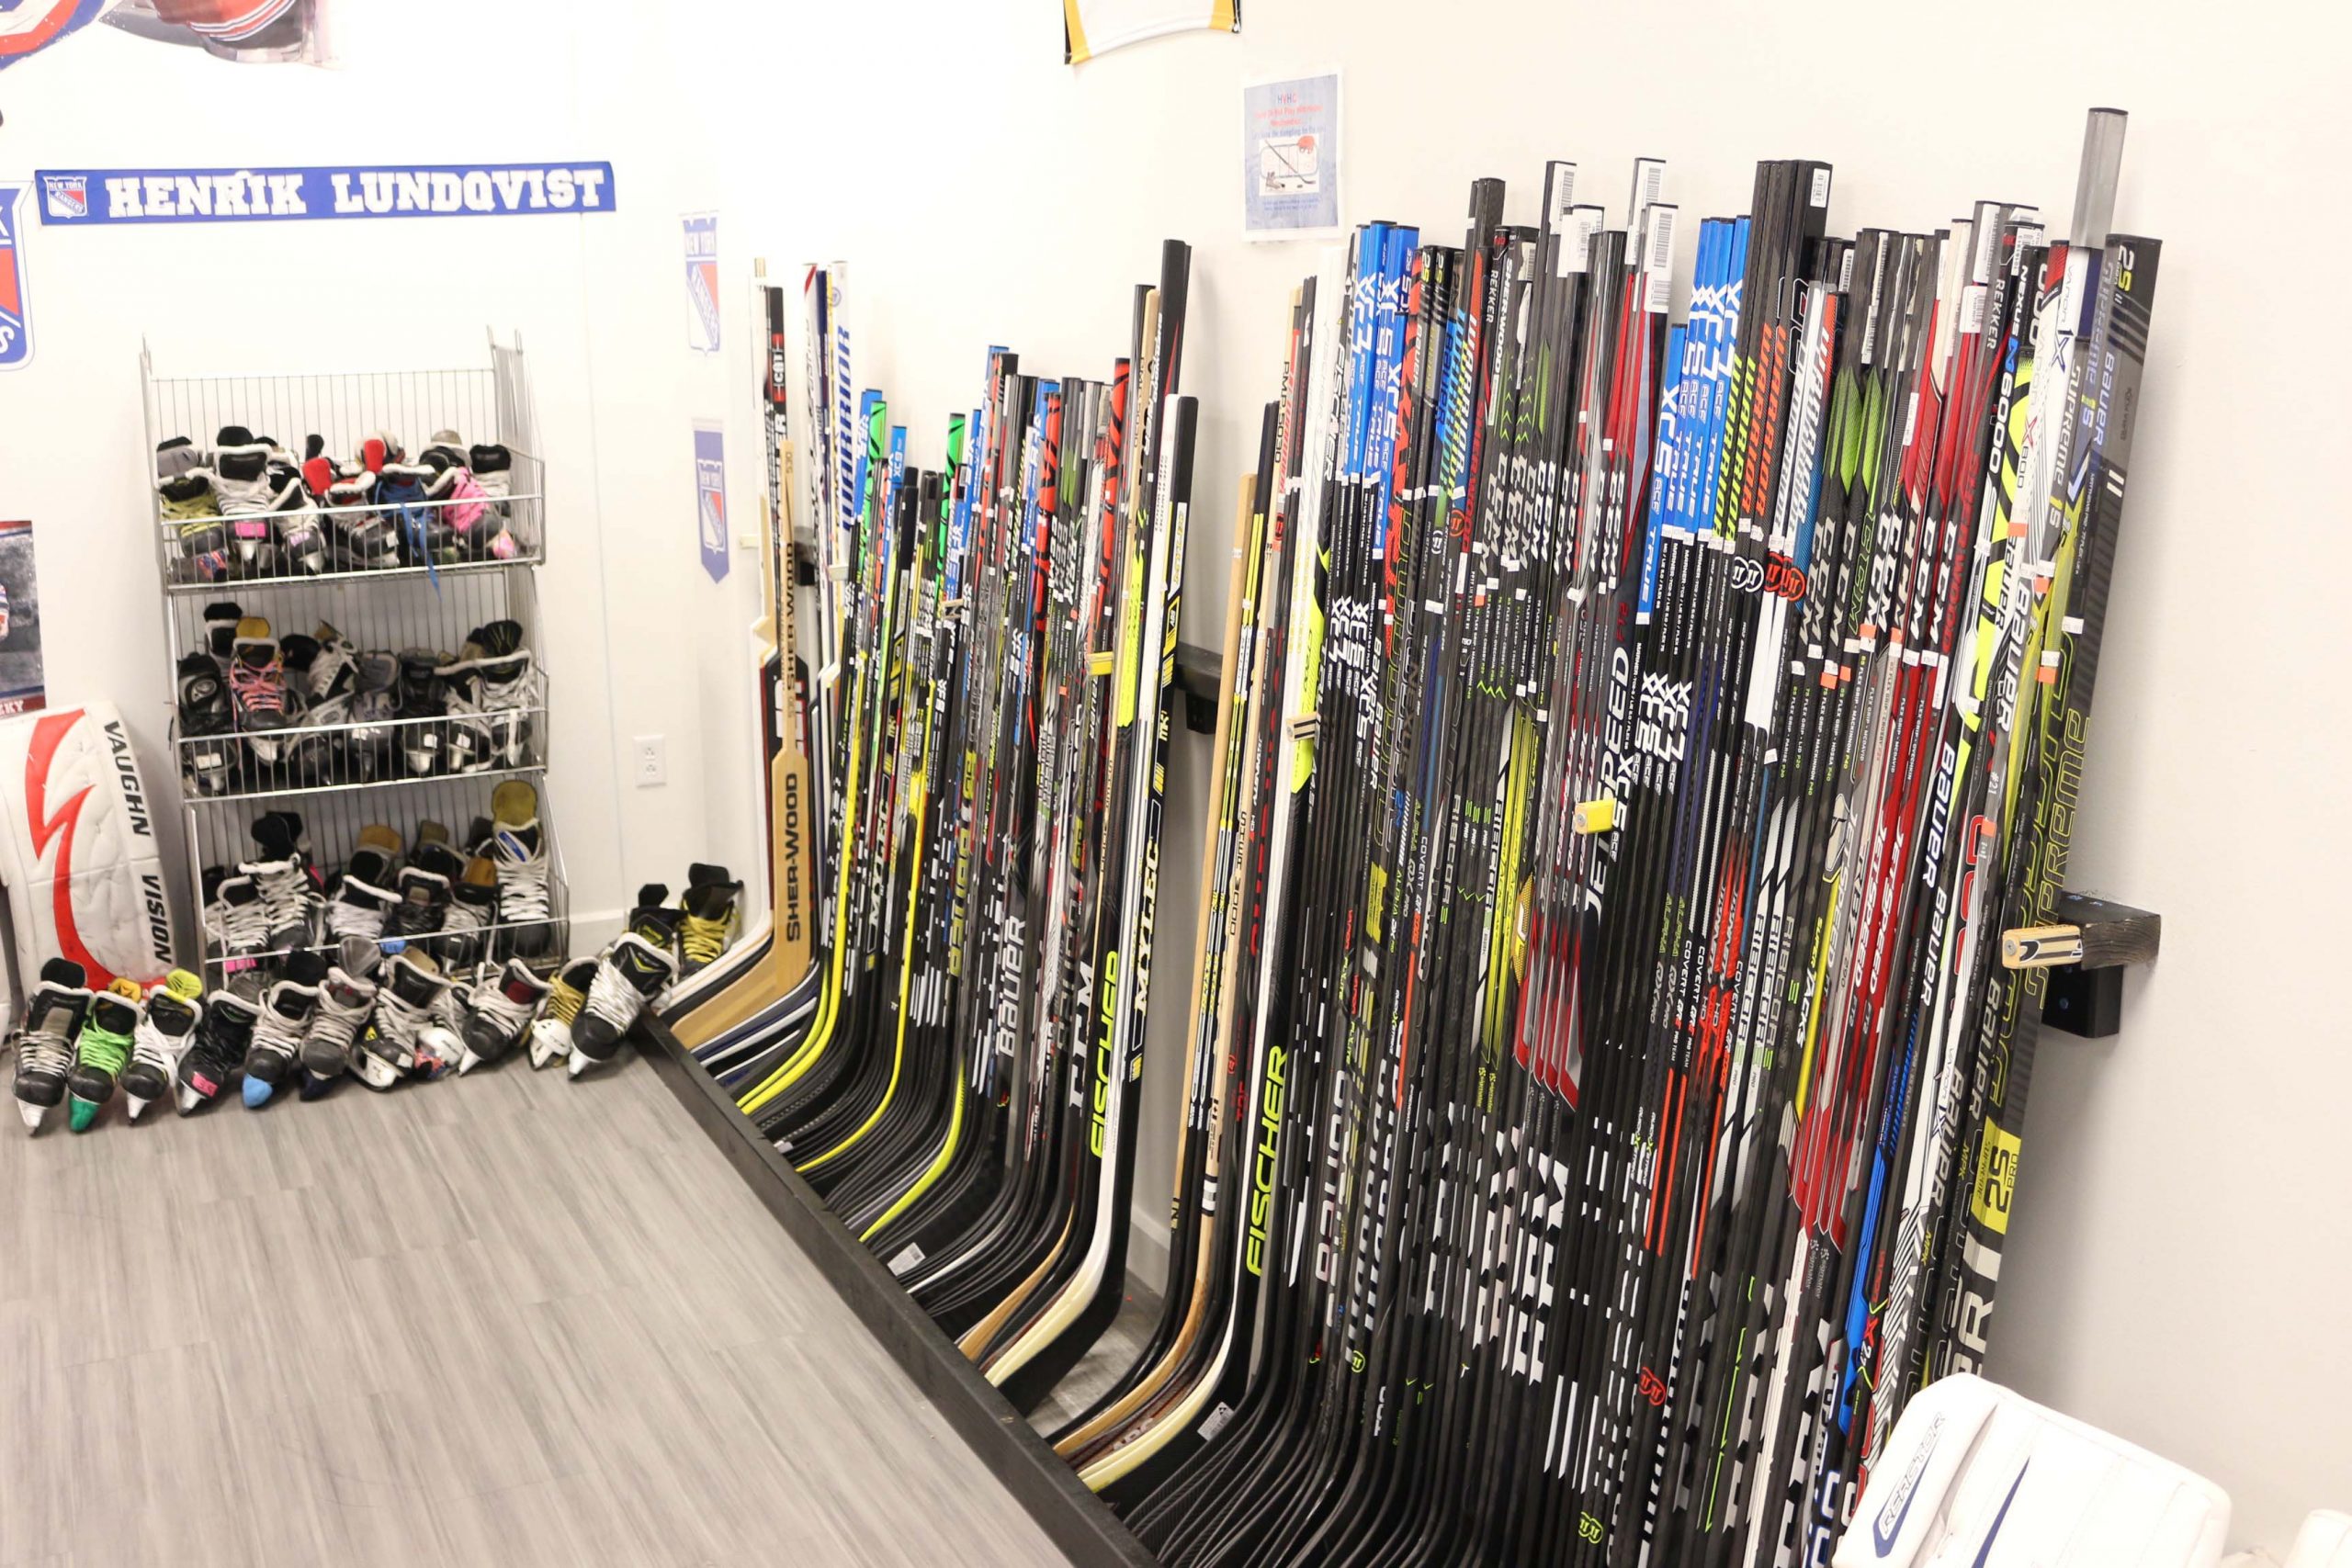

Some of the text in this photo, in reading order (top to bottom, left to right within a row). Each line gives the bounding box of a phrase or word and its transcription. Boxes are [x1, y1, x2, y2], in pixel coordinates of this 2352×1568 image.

[105, 168, 605, 218] HENRIK LUNDQVIST
[1486, 269, 1499, 323] REKKER
[1494, 258, 1513, 374] SHER-WOOD
[1986, 278, 2006, 349] REKKER
[2011, 265, 2029, 336] NEXUS
[2117, 245, 2134, 291] 2S
[1412, 323, 1423, 389] BAUER
[1717, 279, 1744, 378] XC7
[837, 325, 854, 533] WARRIOR
[1275, 412, 1285, 464] 5030
[1324, 342, 1345, 481] FISCHER
[1456, 312, 1477, 473] WARRIOR
[1653, 384, 1680, 478] XC5
[1742, 322, 1772, 514] WARRIOR
[1755, 326, 1787, 517] WARRIOR
[1797, 327, 1830, 525] WARRIOR
[2053, 358, 2081, 485] SUPREME
[2094, 351, 2115, 446] BAUER
[1374, 362, 1401, 547] XC5 TRUE
[1668, 431, 1682, 512] TRUE
[1677, 431, 1692, 512] TRUE
[1689, 435, 1703, 517] TRUE
[1702, 431, 1718, 514] TRUE
[1713, 354, 1742, 537] WARRIOR
[1724, 356, 1756, 542] WARRIOR
[2085, 473, 2095, 512] MATTHEWS
[1480, 473, 1497, 575] CCM
[1520, 465, 1537, 570] CCM
[1531, 459, 1547, 560] CCM
[1542, 460, 1556, 562] CCM
[1553, 467, 1570, 574] CCM
[1565, 472, 1579, 571] CCM
[1589, 470, 1605, 572] CCM
[1610, 470, 1625, 576] CCM
[1641, 526, 1657, 603] TRUE
[1812, 516, 1836, 641] CCM
[1829, 521, 1857, 647] CCM
[1848, 513, 1876, 636] CCM
[1910, 516, 1937, 641] CCM
[1930, 521, 1958, 644] CCM
[785, 542, 796, 691] SHER-WOOD
[1997, 582, 2030, 732] BAUER
[1670, 681, 1692, 761] XC7
[1782, 739, 1792, 763] PARISE
[1810, 739, 1821, 780] MACKINNON
[1828, 742, 1838, 765] HOSSA
[1846, 710, 1858, 753] MACKINNON
[1860, 730, 1869, 761] MCDAVID
[1890, 741, 1900, 773] MCDAVID
[104, 720, 151, 836] VAUGHN
[1410, 799, 1420, 852] ALPHA
[1611, 753, 1634, 831] XC5
[1922, 741, 1956, 888] BAUER
[1987, 772, 1999, 795] #21
[785, 773, 801, 943] SHER-WOOD
[1393, 870, 1402, 916] ALPHA
[1416, 836, 1428, 890] COVERT
[1442, 794, 1461, 904] RIBCOR
[1486, 800, 1502, 908] RIBCOR
[1827, 806, 1858, 968] JETSPEED
[1854, 810, 1887, 987] JETSPEED
[2024, 708, 2090, 1010] SPREME
[141, 874, 172, 964] VISION
[1134, 837, 1159, 1016] MYLEC
[1672, 897, 1685, 957] ALPHA
[1869, 816, 1904, 995] JETSPEED
[1920, 886, 1947, 1006] BAUER
[995, 916, 1026, 1057] BAUER
[1650, 892, 1672, 1023] ALPHA PRO
[1679, 940, 1691, 997] COVERT
[1693, 946, 1705, 1003] COVERT
[1729, 960, 1744, 1024] COVERT
[1767, 917, 1794, 1046] RIBCOR
[1796, 916, 1823, 1049] SUPER TACKS
[1663, 1004, 1671, 1029] PRO
[1968, 976, 2001, 1121] BAUER
[1246, 1045, 1288, 1277] FISCHER
[1930, 1065, 1965, 1208] BAUER
[1957, 1141, 1970, 1181] MPK
[1984, 1145, 2010, 1213] 2S
[2007, 1154, 2018, 1189] PRO
[1921, 1231, 1932, 1267] MPK
[1880, 1411, 1945, 1533] REACTOR
